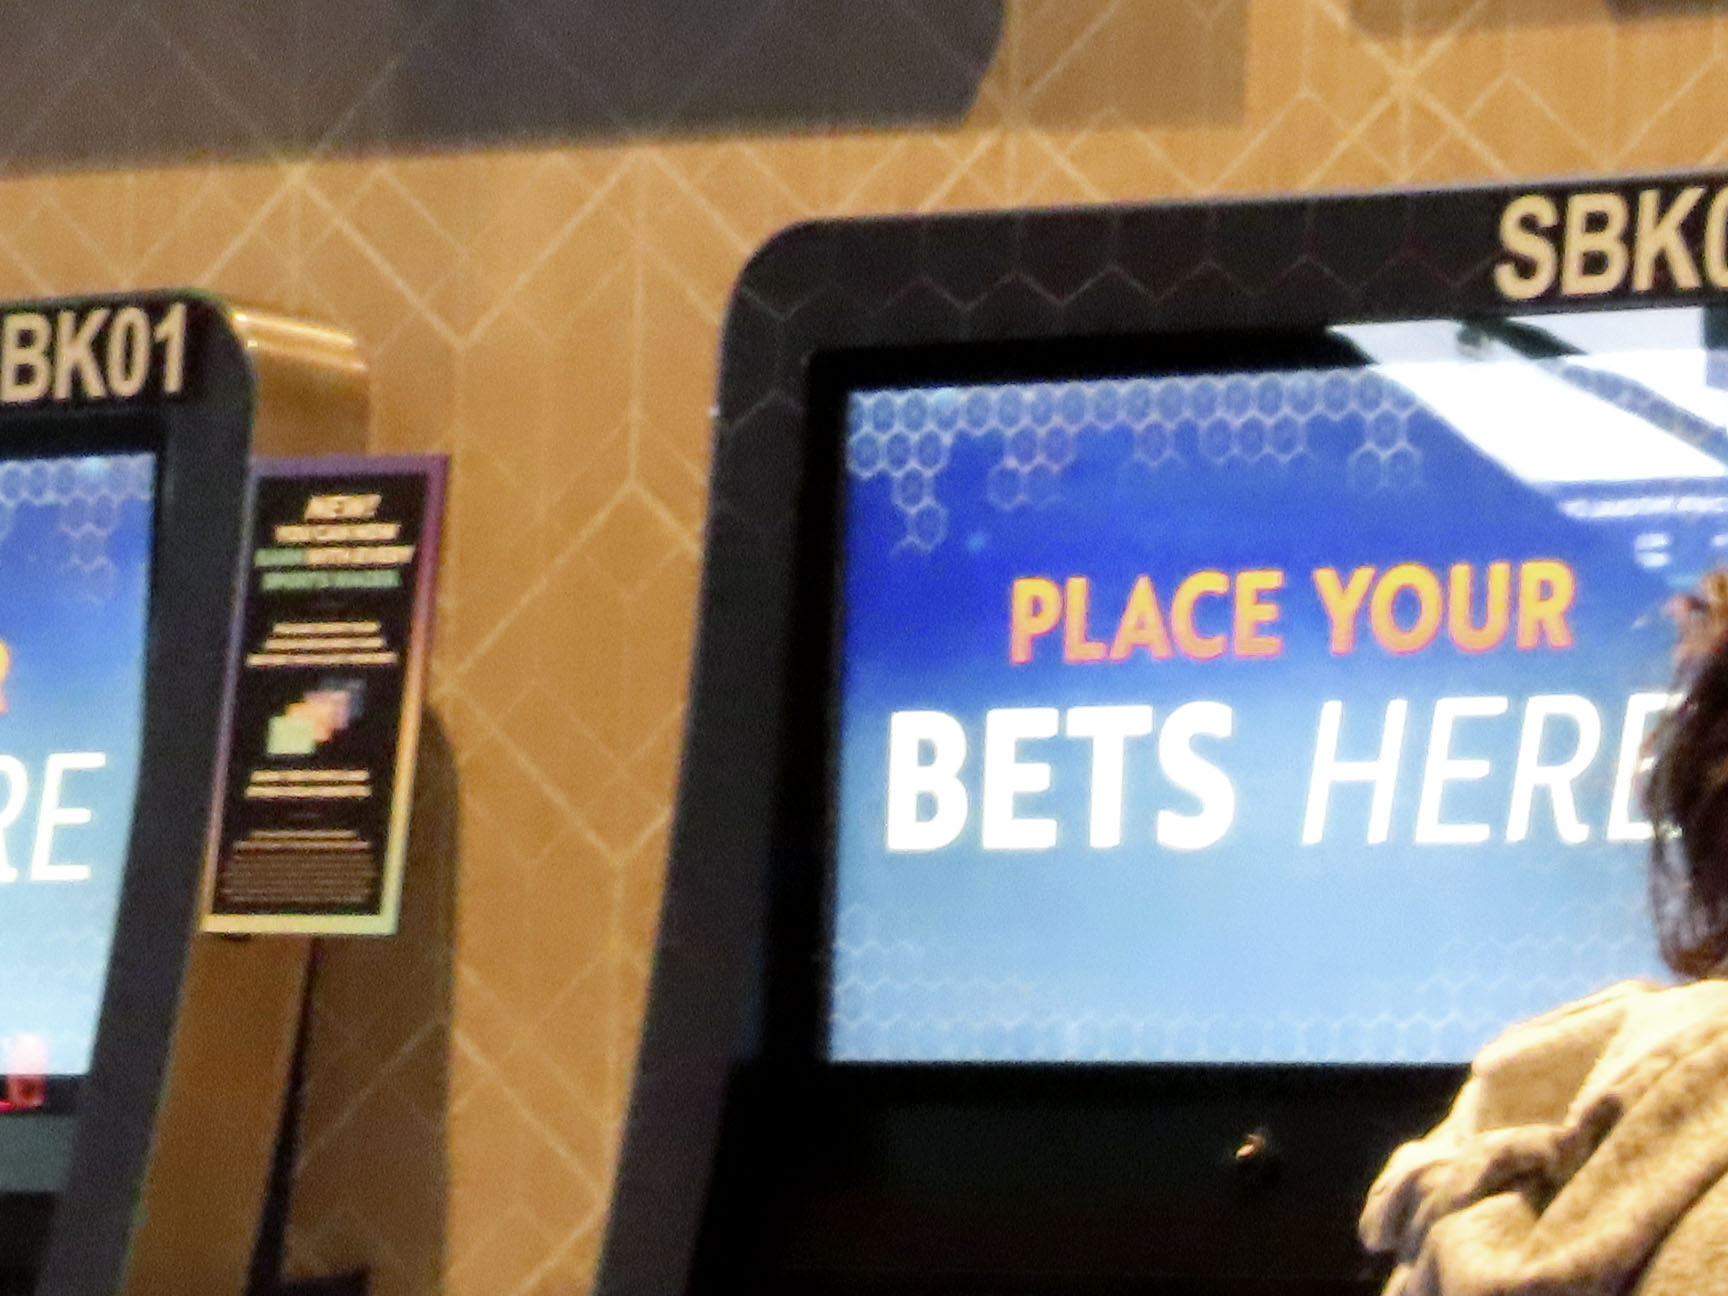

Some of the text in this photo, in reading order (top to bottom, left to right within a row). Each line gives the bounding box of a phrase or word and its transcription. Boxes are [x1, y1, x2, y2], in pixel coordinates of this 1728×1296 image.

[1, 302, 187, 401] BK01
[1009, 558, 1577, 664] PLACE YOUR
[884, 700, 1235, 852] BETS
